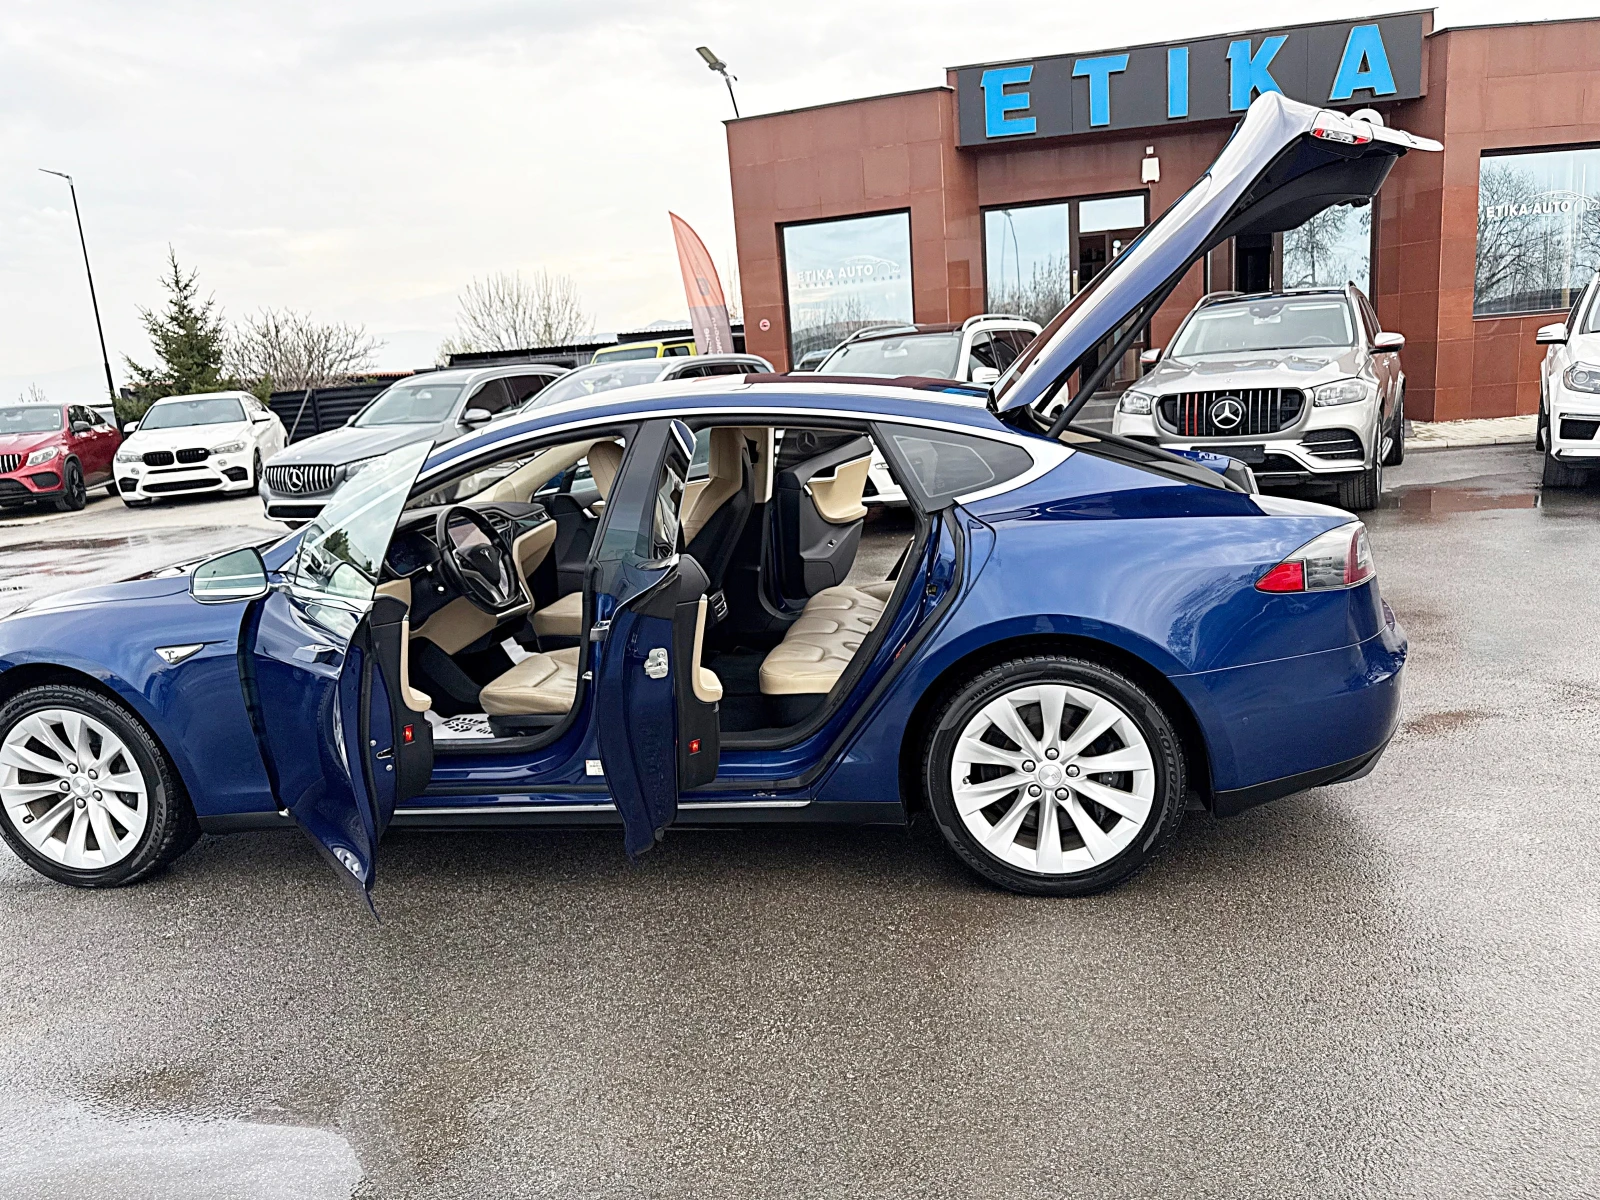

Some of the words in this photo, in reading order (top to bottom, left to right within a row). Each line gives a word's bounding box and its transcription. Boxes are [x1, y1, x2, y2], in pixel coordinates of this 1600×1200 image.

[980, 23, 1397, 139] ETIKA
[1486, 204, 1529, 218] ETIKA
[1532, 200, 1571, 214] AUTO
[797, 268, 835, 283] ETIKA
[838, 264, 874, 278] AUTO
